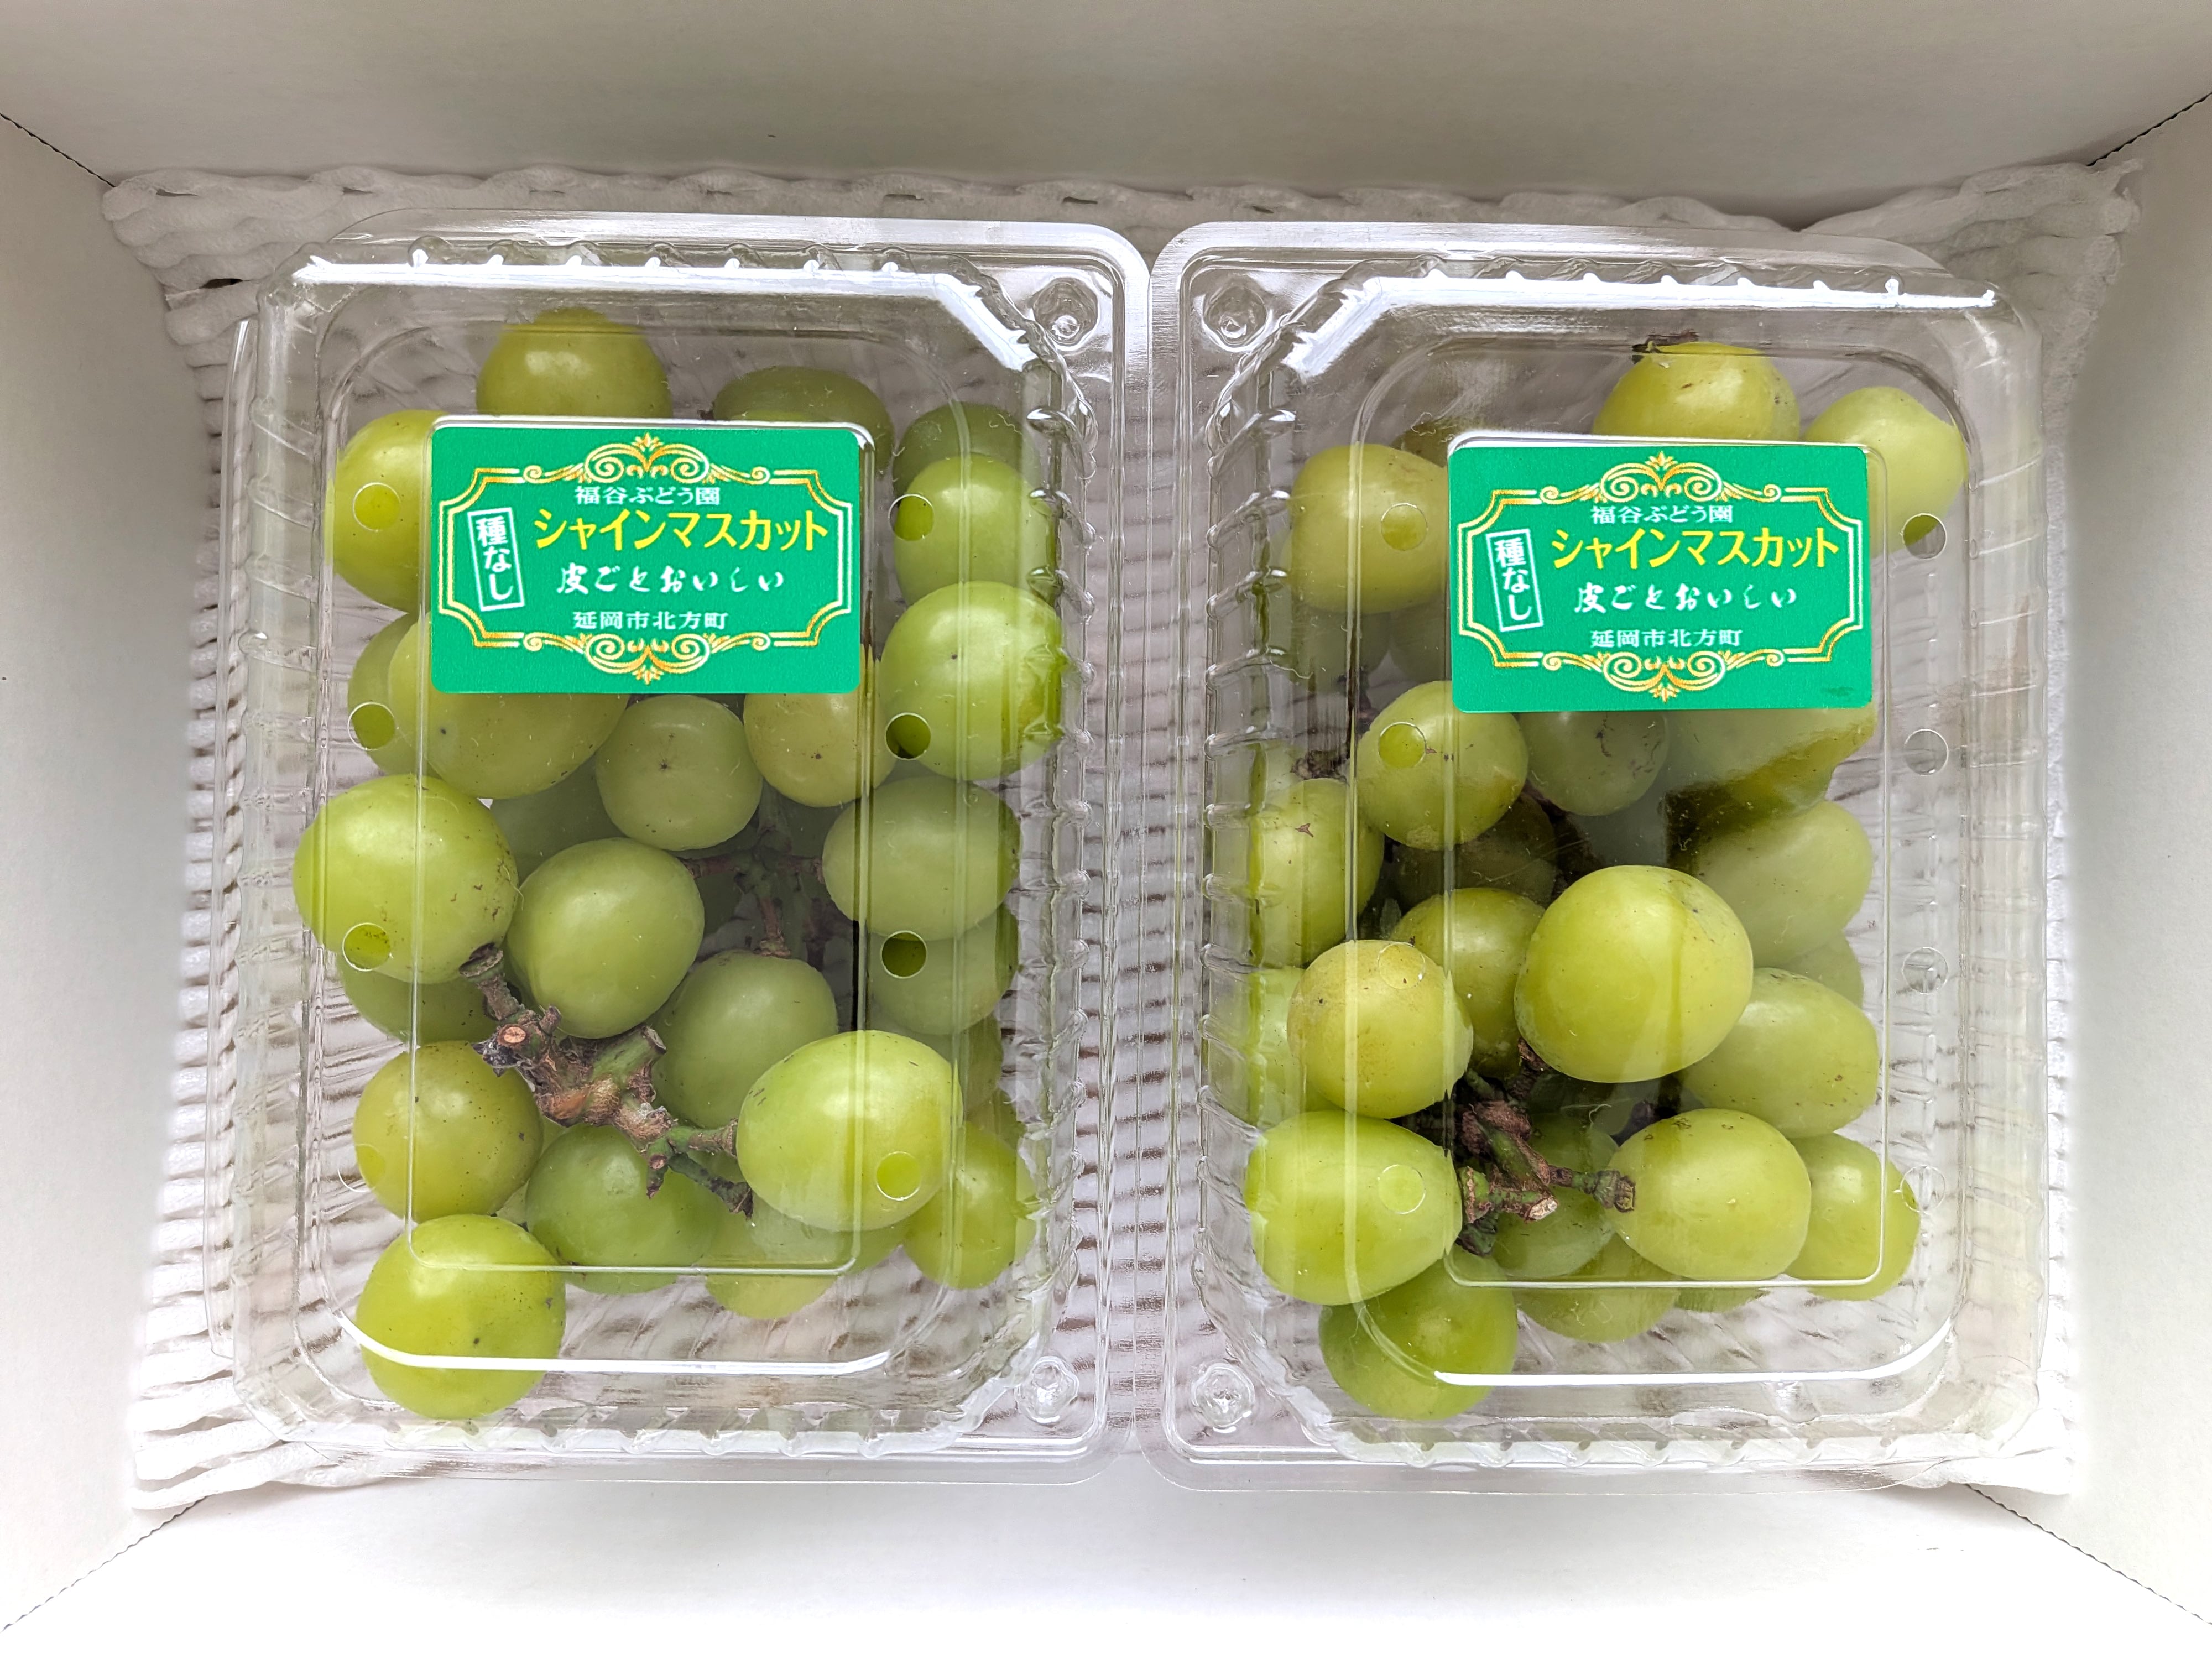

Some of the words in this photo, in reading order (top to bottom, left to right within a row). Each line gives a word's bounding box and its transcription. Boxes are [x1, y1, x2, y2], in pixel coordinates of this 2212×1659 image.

[575, 486, 720, 505] 福谷ぶどう園
[534, 509, 828, 551] シャインマスカット
[1590, 505, 1733, 524] 福谷ぶどう園
[476, 515, 514, 601] 種なし
[1551, 527, 1839, 569] シャインマスカット
[557, 563, 784, 594] 皮ごとおいしい
[1494, 537, 1532, 621] 種なし
[1574, 582, 1797, 613] 皮ごとおいしい
[573, 611, 728, 630] 延岡市北方町
[1590, 629, 1743, 648] 延岡市北方町
